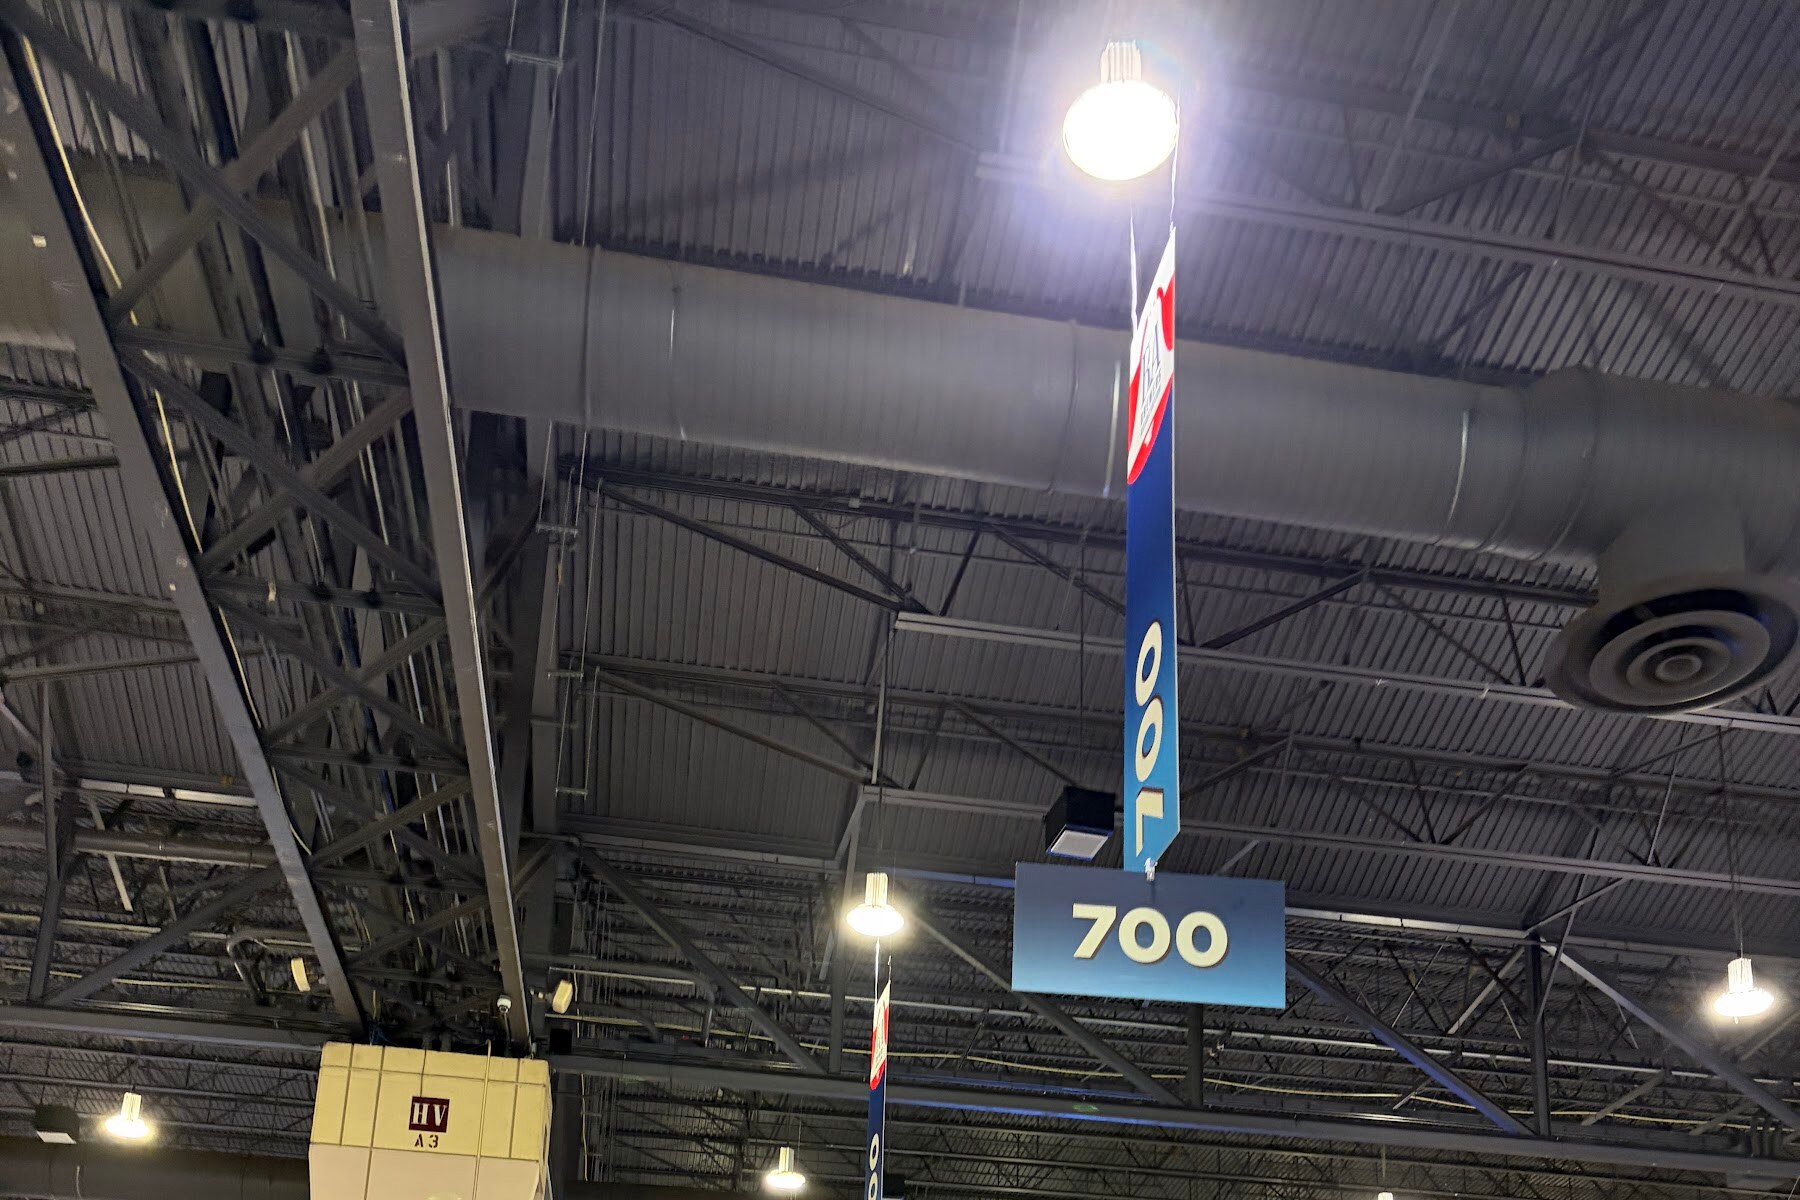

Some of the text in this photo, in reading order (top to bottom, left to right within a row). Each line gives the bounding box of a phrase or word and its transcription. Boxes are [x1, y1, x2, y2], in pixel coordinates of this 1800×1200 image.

[1135, 621, 1164, 857] 700
[1072, 903, 1229, 968] 700
[410, 1102, 447, 1127] HV
